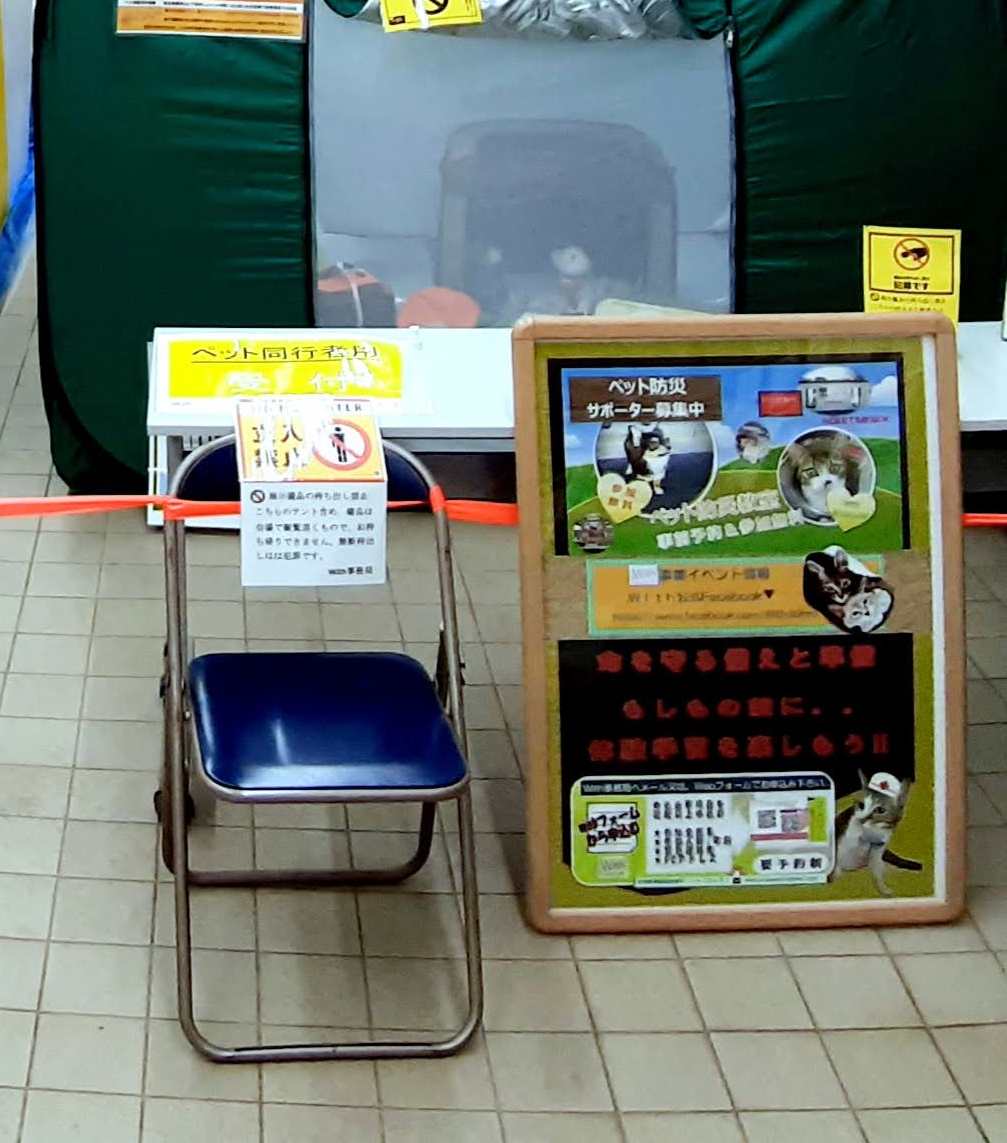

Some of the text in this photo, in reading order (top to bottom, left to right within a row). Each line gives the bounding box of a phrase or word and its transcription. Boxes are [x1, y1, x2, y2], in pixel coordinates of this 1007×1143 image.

[607, 377, 688, 397] ペット防災
[585, 401, 705, 420] サポーター募集中
